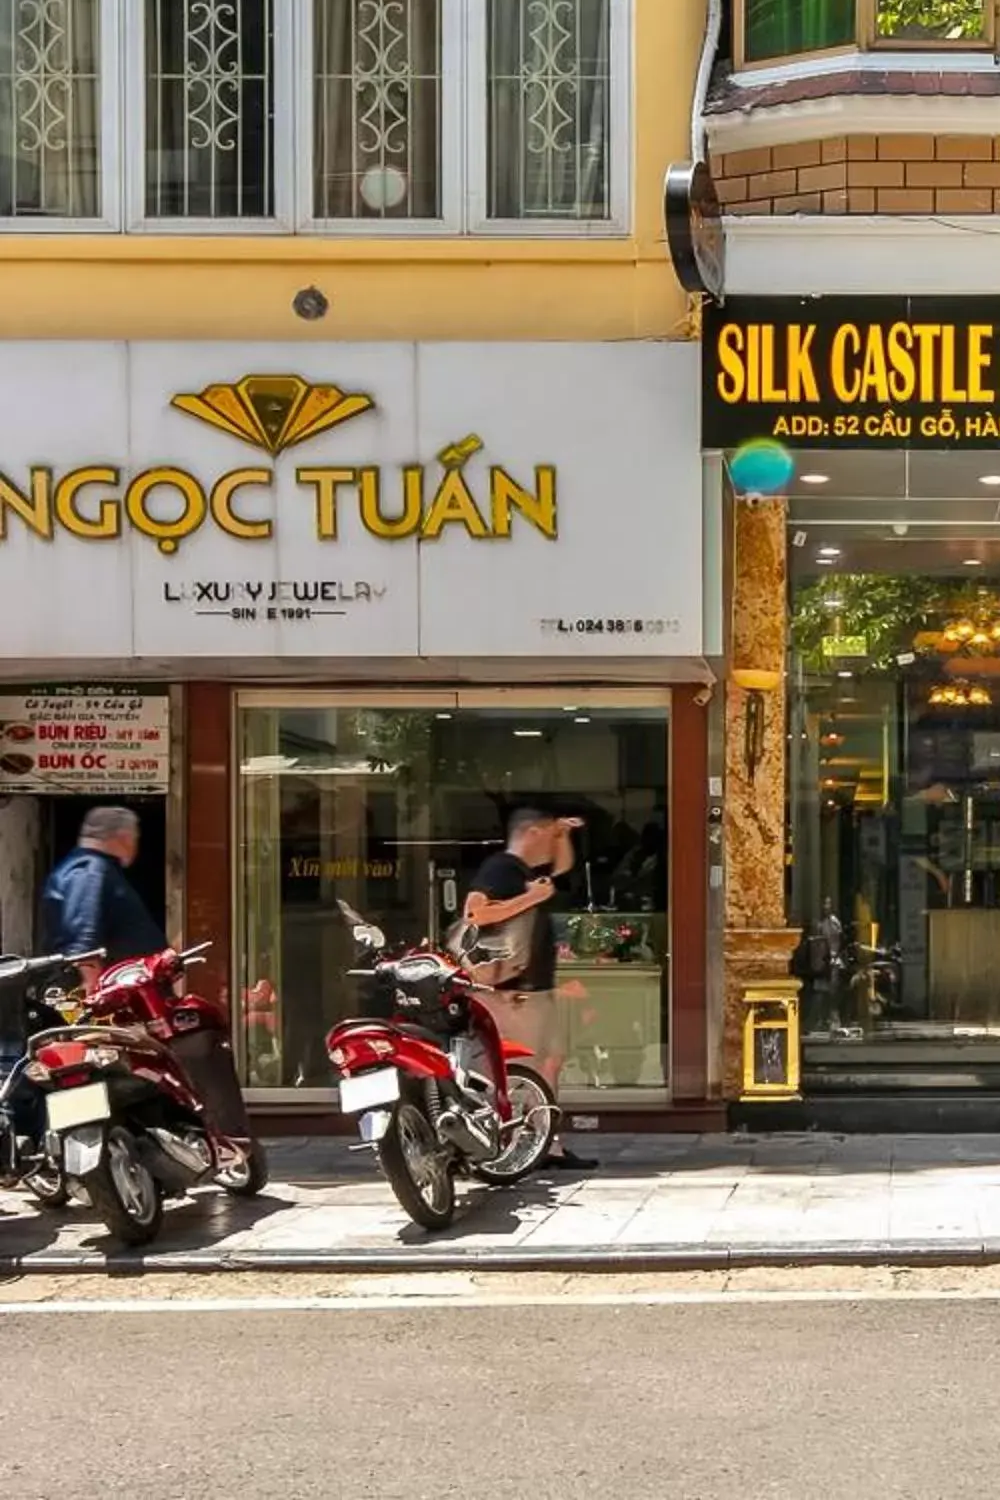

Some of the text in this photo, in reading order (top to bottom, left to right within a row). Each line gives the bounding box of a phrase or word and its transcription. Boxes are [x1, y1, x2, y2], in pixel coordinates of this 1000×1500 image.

[717, 322, 821, 404] SILK
[831, 321, 994, 404] CASTLE
[772, 416, 830, 437] ADD:
[833, 415, 859, 436] 52
[864, 408, 911, 438] CẦU
[920, 408, 961, 440] GỖ,
[0, 433, 558, 556] NGỌC TUẤN
[164, 582, 263, 602] LXUY
[231, 607, 278, 620] SINE
[80, 749, 107, 769] ỐC
